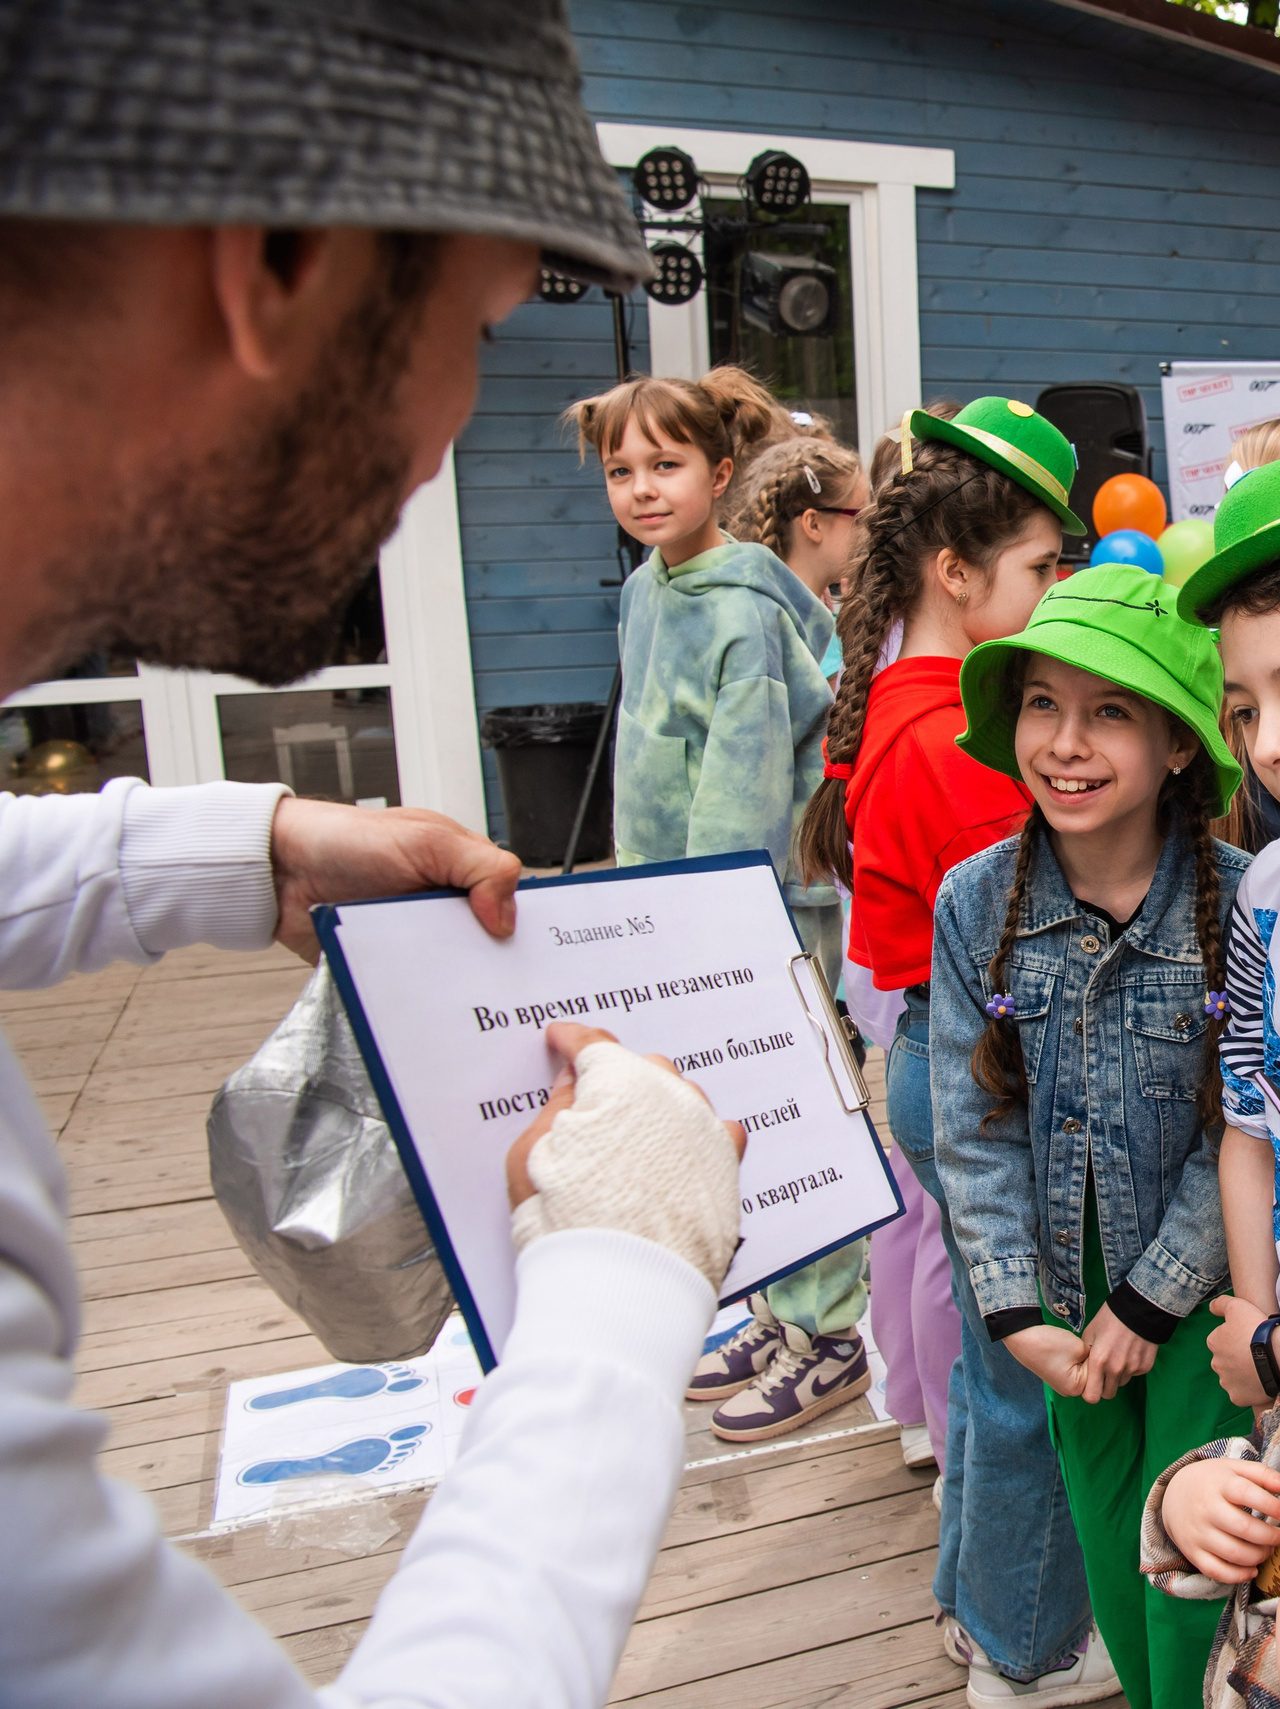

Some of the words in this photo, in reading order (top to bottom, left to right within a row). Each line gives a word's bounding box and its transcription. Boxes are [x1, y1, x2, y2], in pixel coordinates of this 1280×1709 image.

[548, 924, 624, 946] Задание
[625, 915, 656, 936] №5
[472, 1005, 510, 1033] Во
[513, 996, 591, 1030] время
[593, 984, 654, 1013] игры
[655, 966, 755, 1000] незаметно
[478, 1085, 553, 1121] поста
[726, 1030, 796, 1061] больше
[756, 1166, 843, 1205] квартала.
